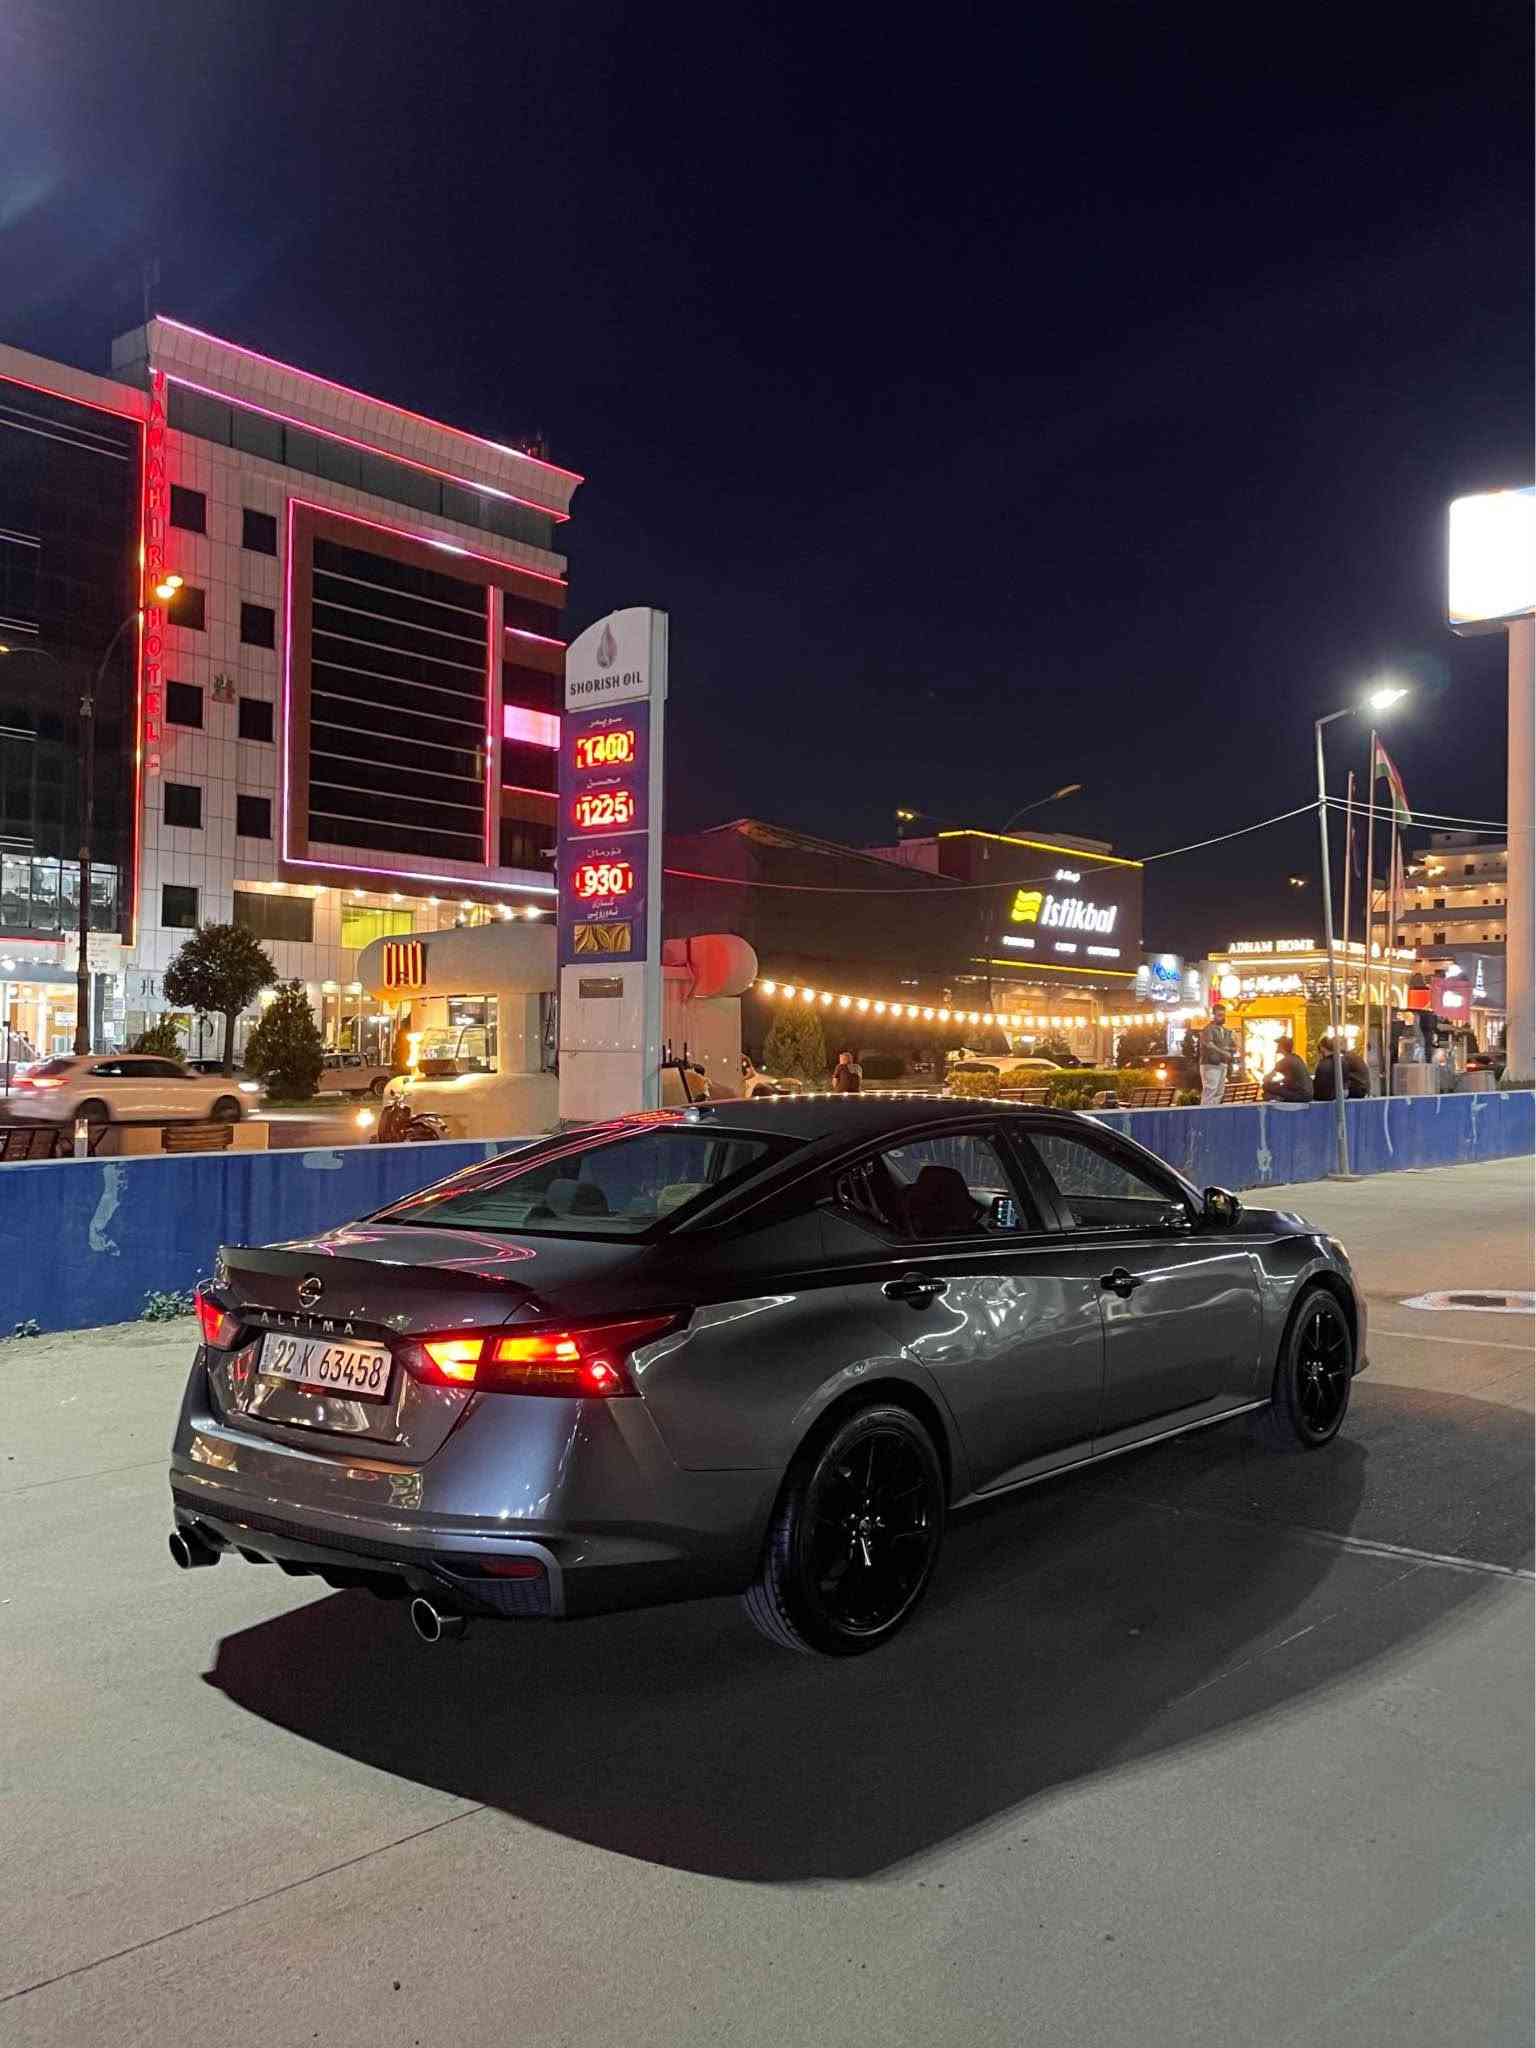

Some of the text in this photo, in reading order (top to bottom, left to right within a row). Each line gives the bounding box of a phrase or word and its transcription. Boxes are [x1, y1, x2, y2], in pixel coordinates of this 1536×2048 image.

[144, 607, 162, 742] HOTEL
[570, 671, 645, 696] SHORISH OIL
[581, 732, 629, 765] 1400
[580, 795, 629, 827] 1225
[583, 867, 624, 895] 930
[260, 1310, 356, 1336] ALTIMA
[273, 1338, 298, 1374] 22
[300, 1343, 317, 1377] K
[319, 1347, 384, 1388] 63458
